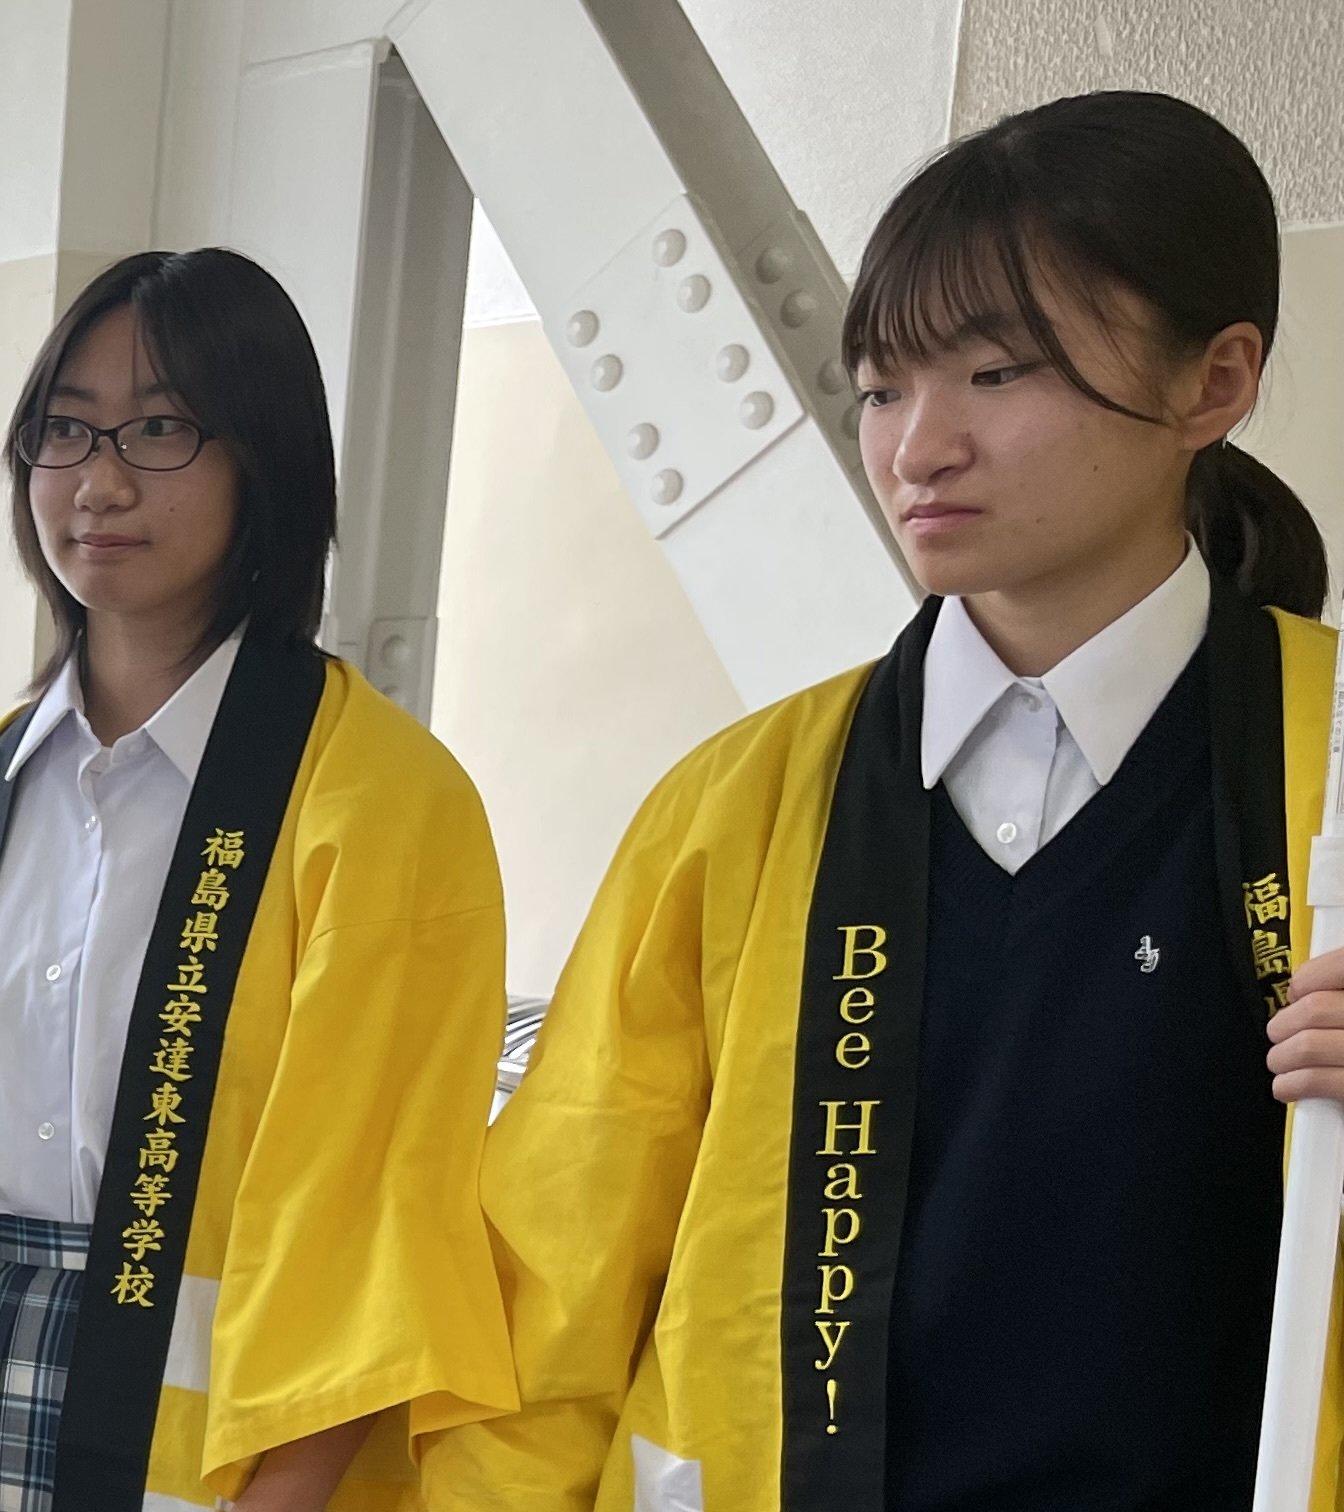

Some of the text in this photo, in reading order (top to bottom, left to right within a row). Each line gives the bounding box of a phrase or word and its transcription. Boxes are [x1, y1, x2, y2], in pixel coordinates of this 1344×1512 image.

[109, 827, 246, 1308] 福島県立安達東高等学校
[814, 924, 889, 1436] Bee Happy!
